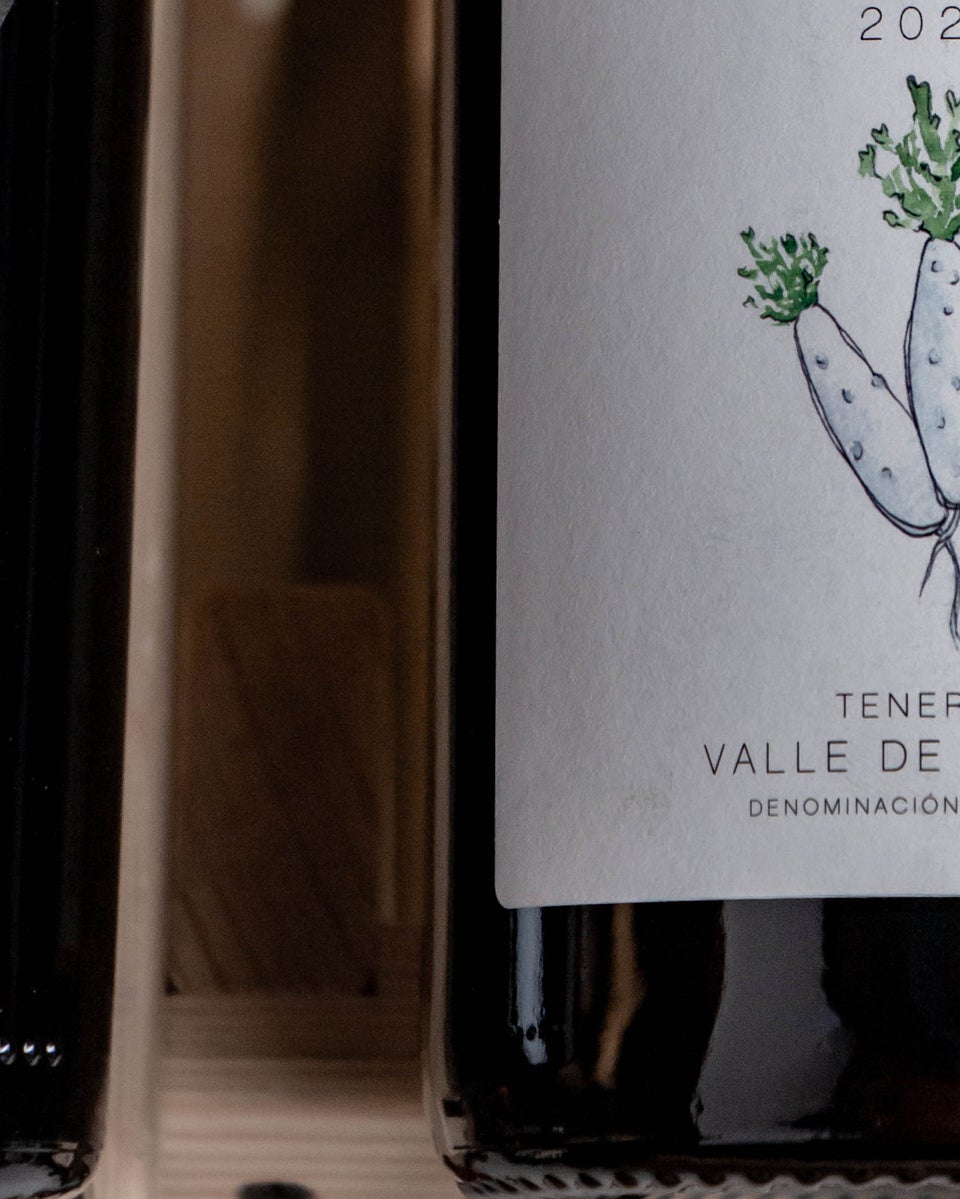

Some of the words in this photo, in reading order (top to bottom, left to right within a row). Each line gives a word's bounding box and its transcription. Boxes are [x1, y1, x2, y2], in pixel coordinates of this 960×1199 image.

[703, 739, 849, 776] VALLE
[881, 738, 941, 773] DE
[749, 791, 959, 818] DENOMINACIÓN
